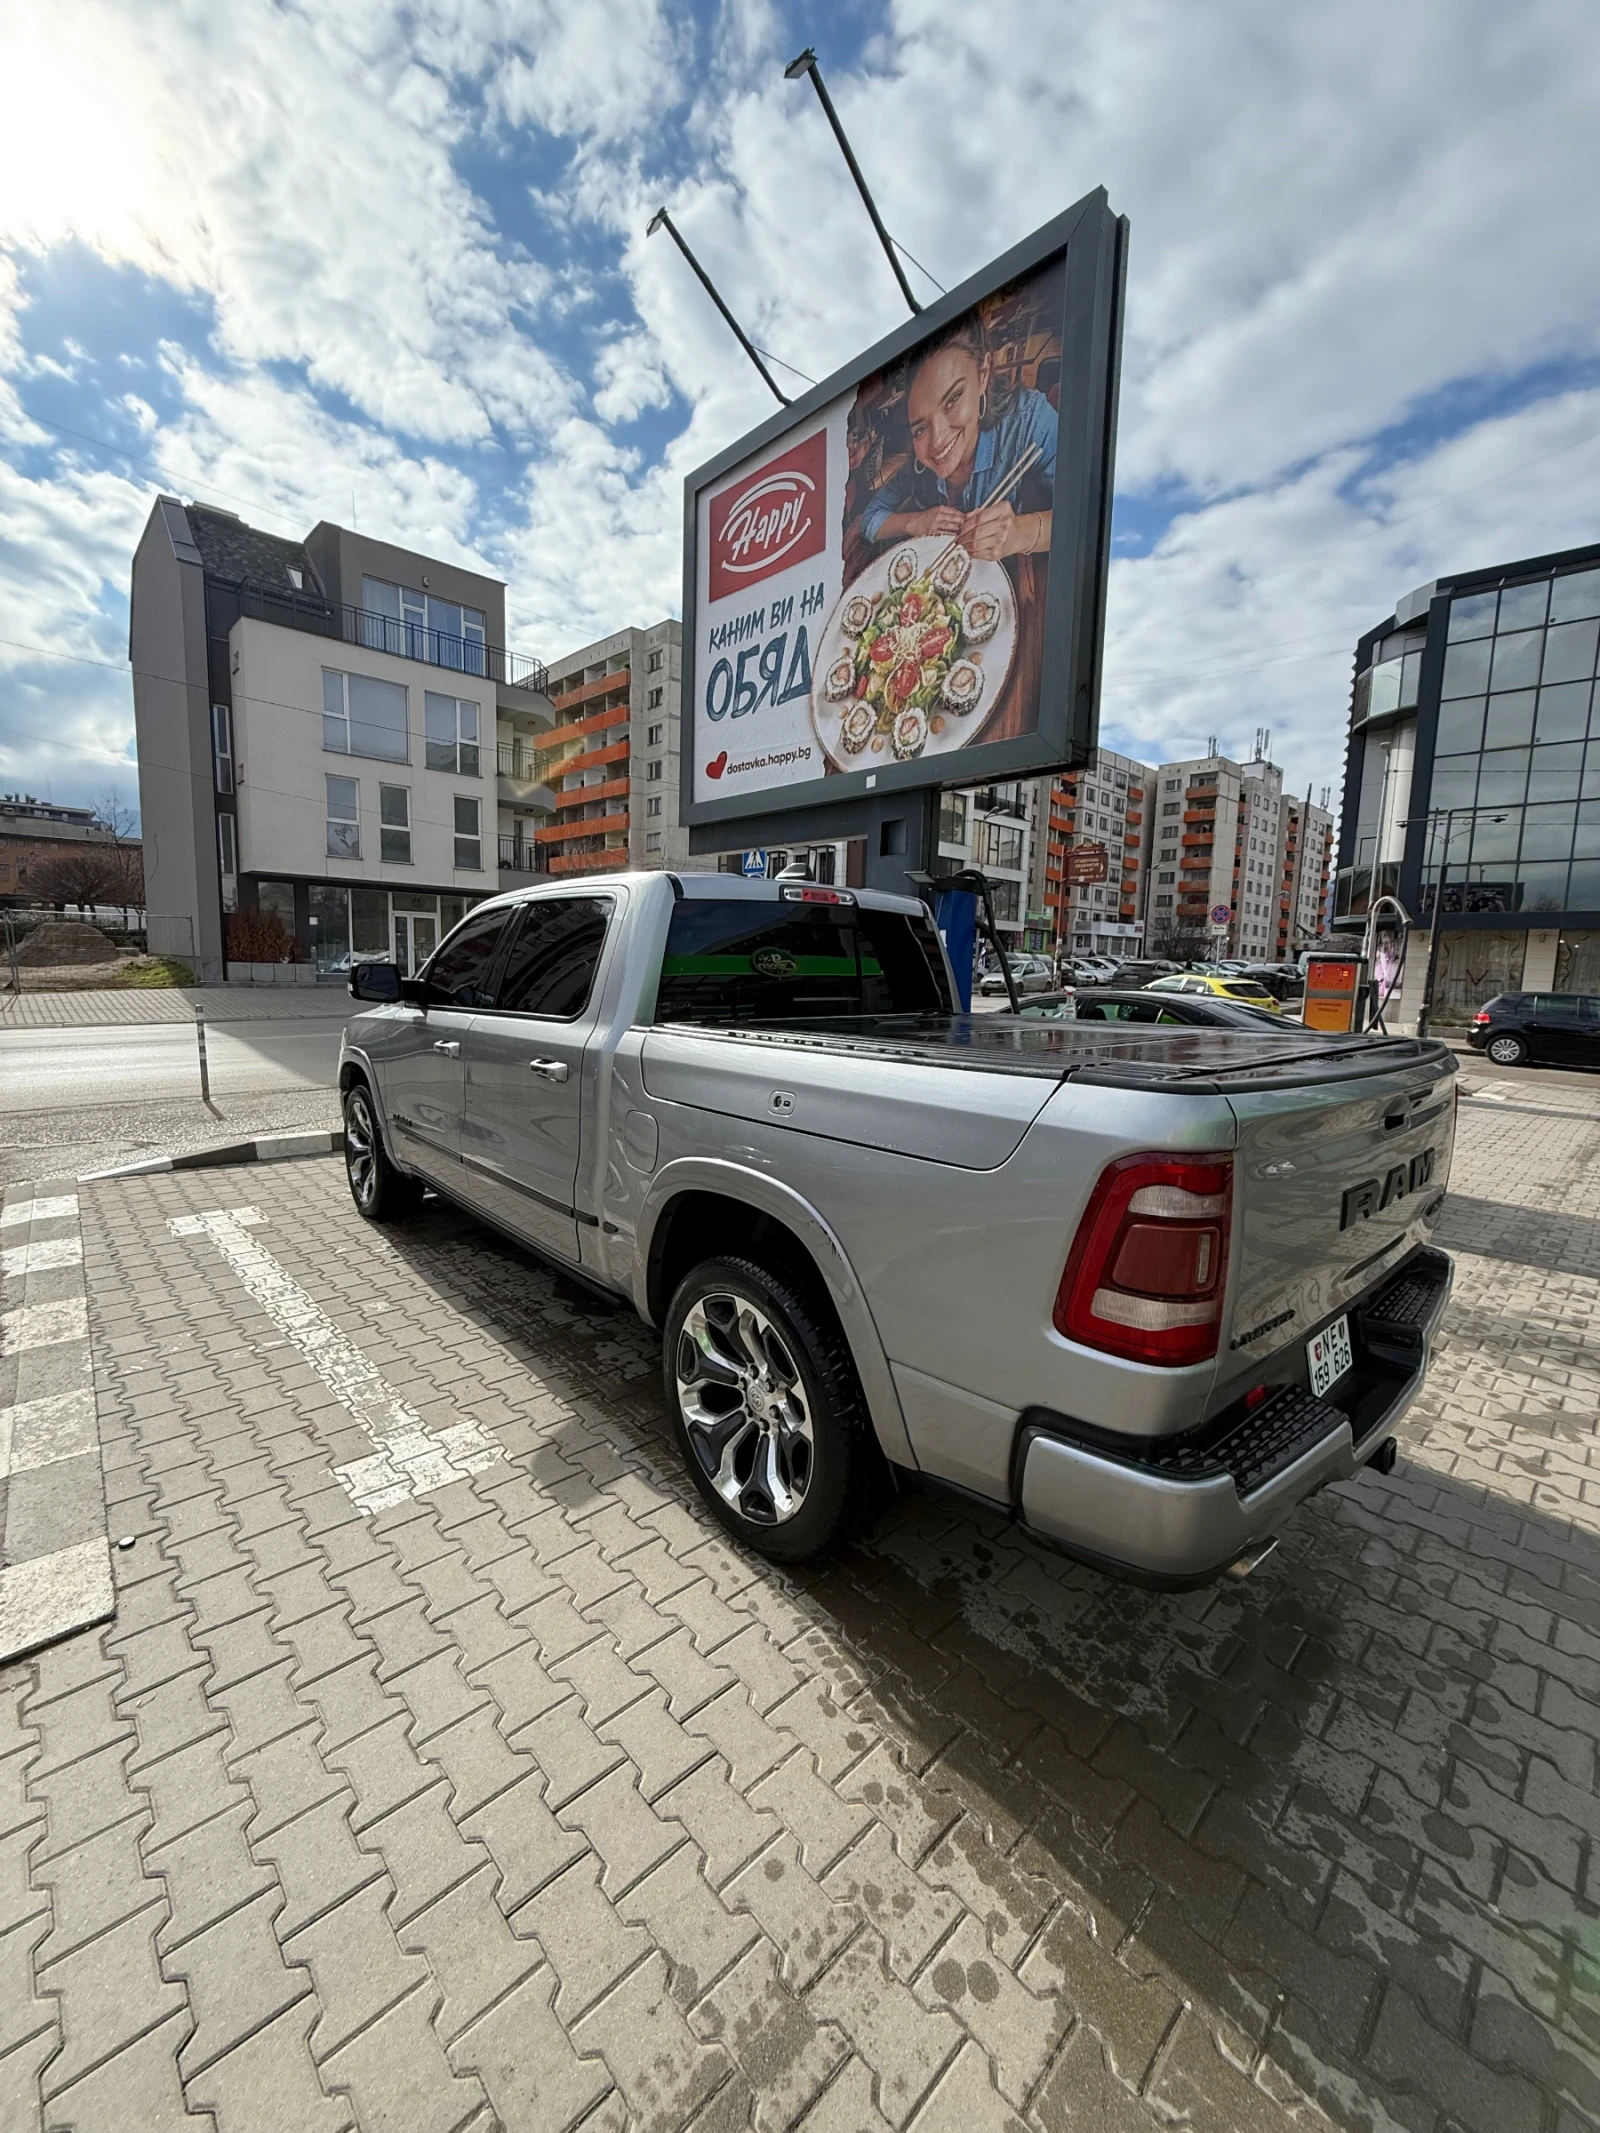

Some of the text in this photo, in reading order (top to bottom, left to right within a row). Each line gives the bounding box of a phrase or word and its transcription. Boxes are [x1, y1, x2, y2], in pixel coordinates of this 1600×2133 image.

[727, 492, 806, 561] Happy
[709, 582, 825, 653] КАНИМ ВИ НА
[706, 625, 813, 722] ОБЯД
[727, 746, 811, 774] dostavka.happy.bg
[1340, 1147, 1435, 1232] RAM
[1315, 1342, 1350, 1394] 159 626
[1322, 1324, 1337, 1357] NE
